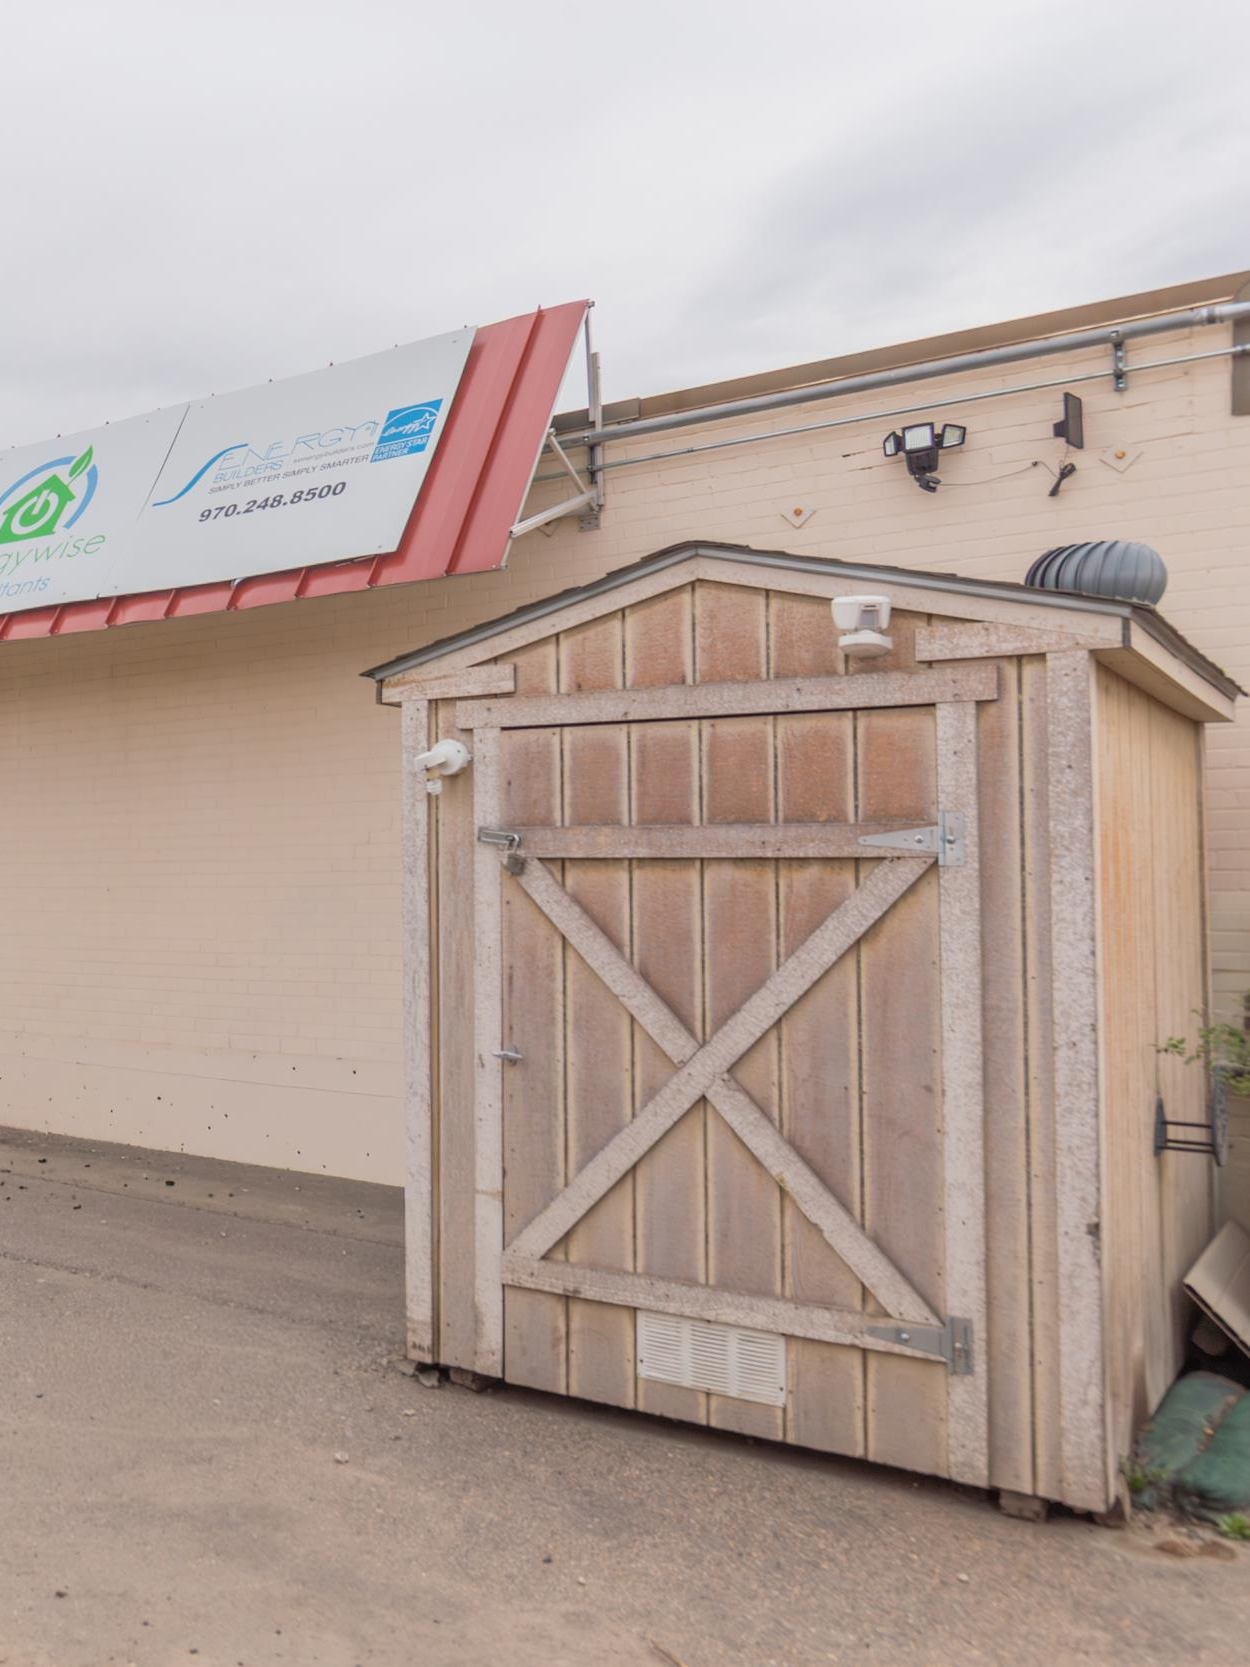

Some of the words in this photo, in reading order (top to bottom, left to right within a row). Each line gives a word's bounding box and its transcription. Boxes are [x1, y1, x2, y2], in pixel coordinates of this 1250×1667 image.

[207, 479, 242, 494] SIMPLY
[243, 473, 281, 489] BETTER
[282, 464, 319, 480] SIMPLY
[320, 454, 369, 472] SMARTER
[213, 459, 285, 484] BUILDERS
[199, 481, 347, 523] 970.248.8500
